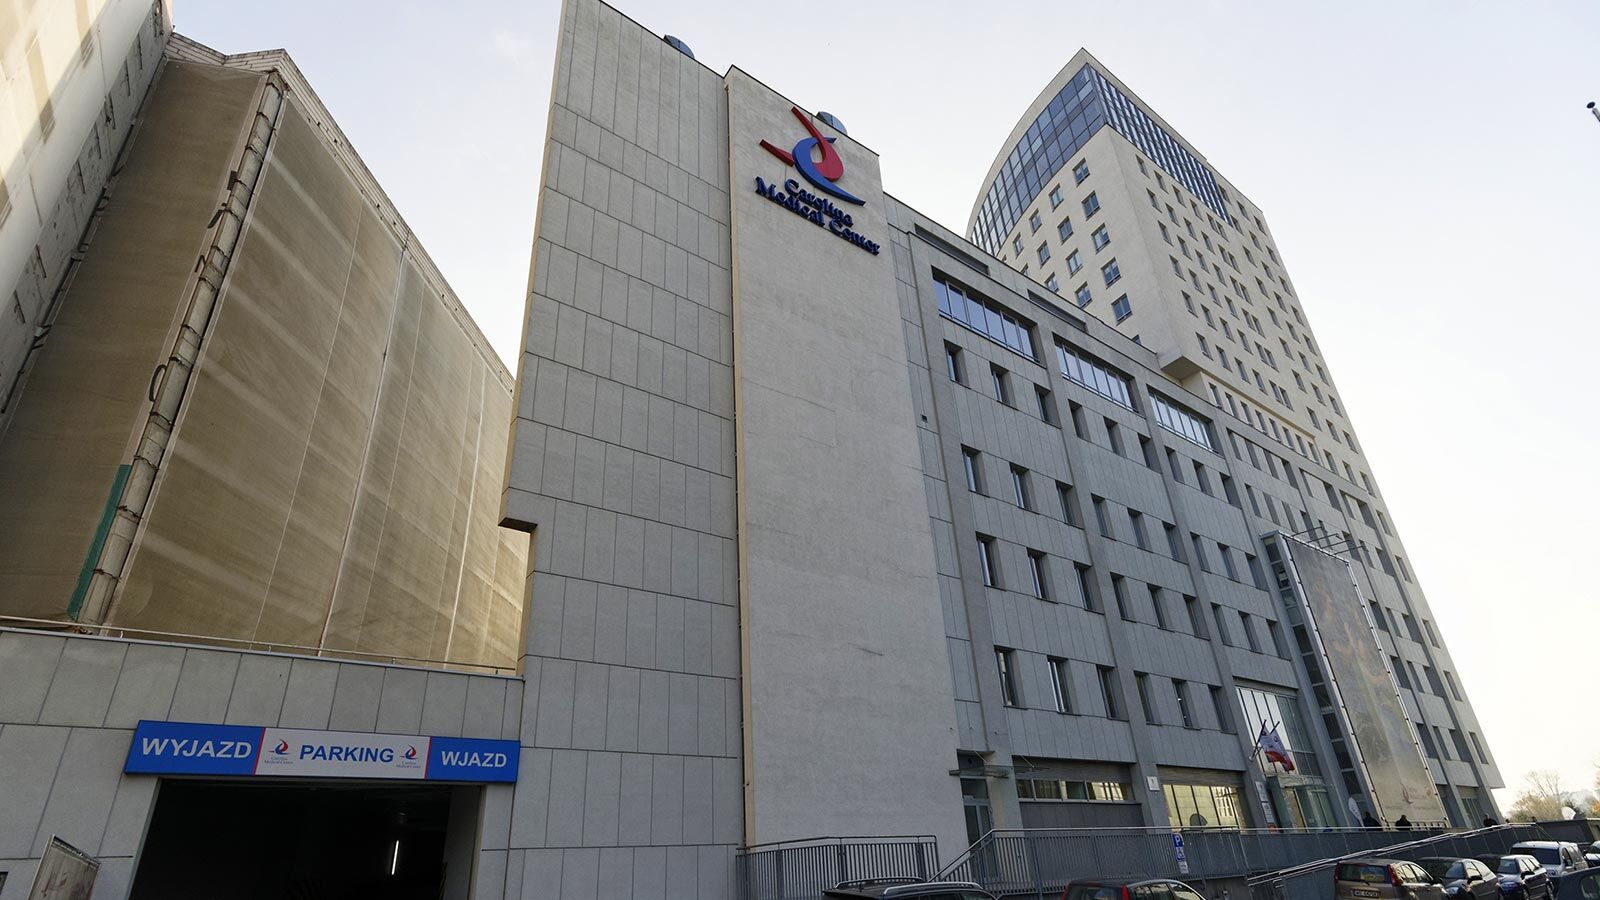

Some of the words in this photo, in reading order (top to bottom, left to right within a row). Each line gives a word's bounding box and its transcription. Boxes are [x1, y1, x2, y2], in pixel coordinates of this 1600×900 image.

[755, 176, 825, 227] Medical
[829, 219, 880, 256] Center
[785, 179, 853, 227] Carolina
[142, 737, 252, 759] WYJAZD
[300, 744, 394, 764] PARKING
[441, 751, 507, 768] WJAZD
[1175, 835, 1181, 846] P
